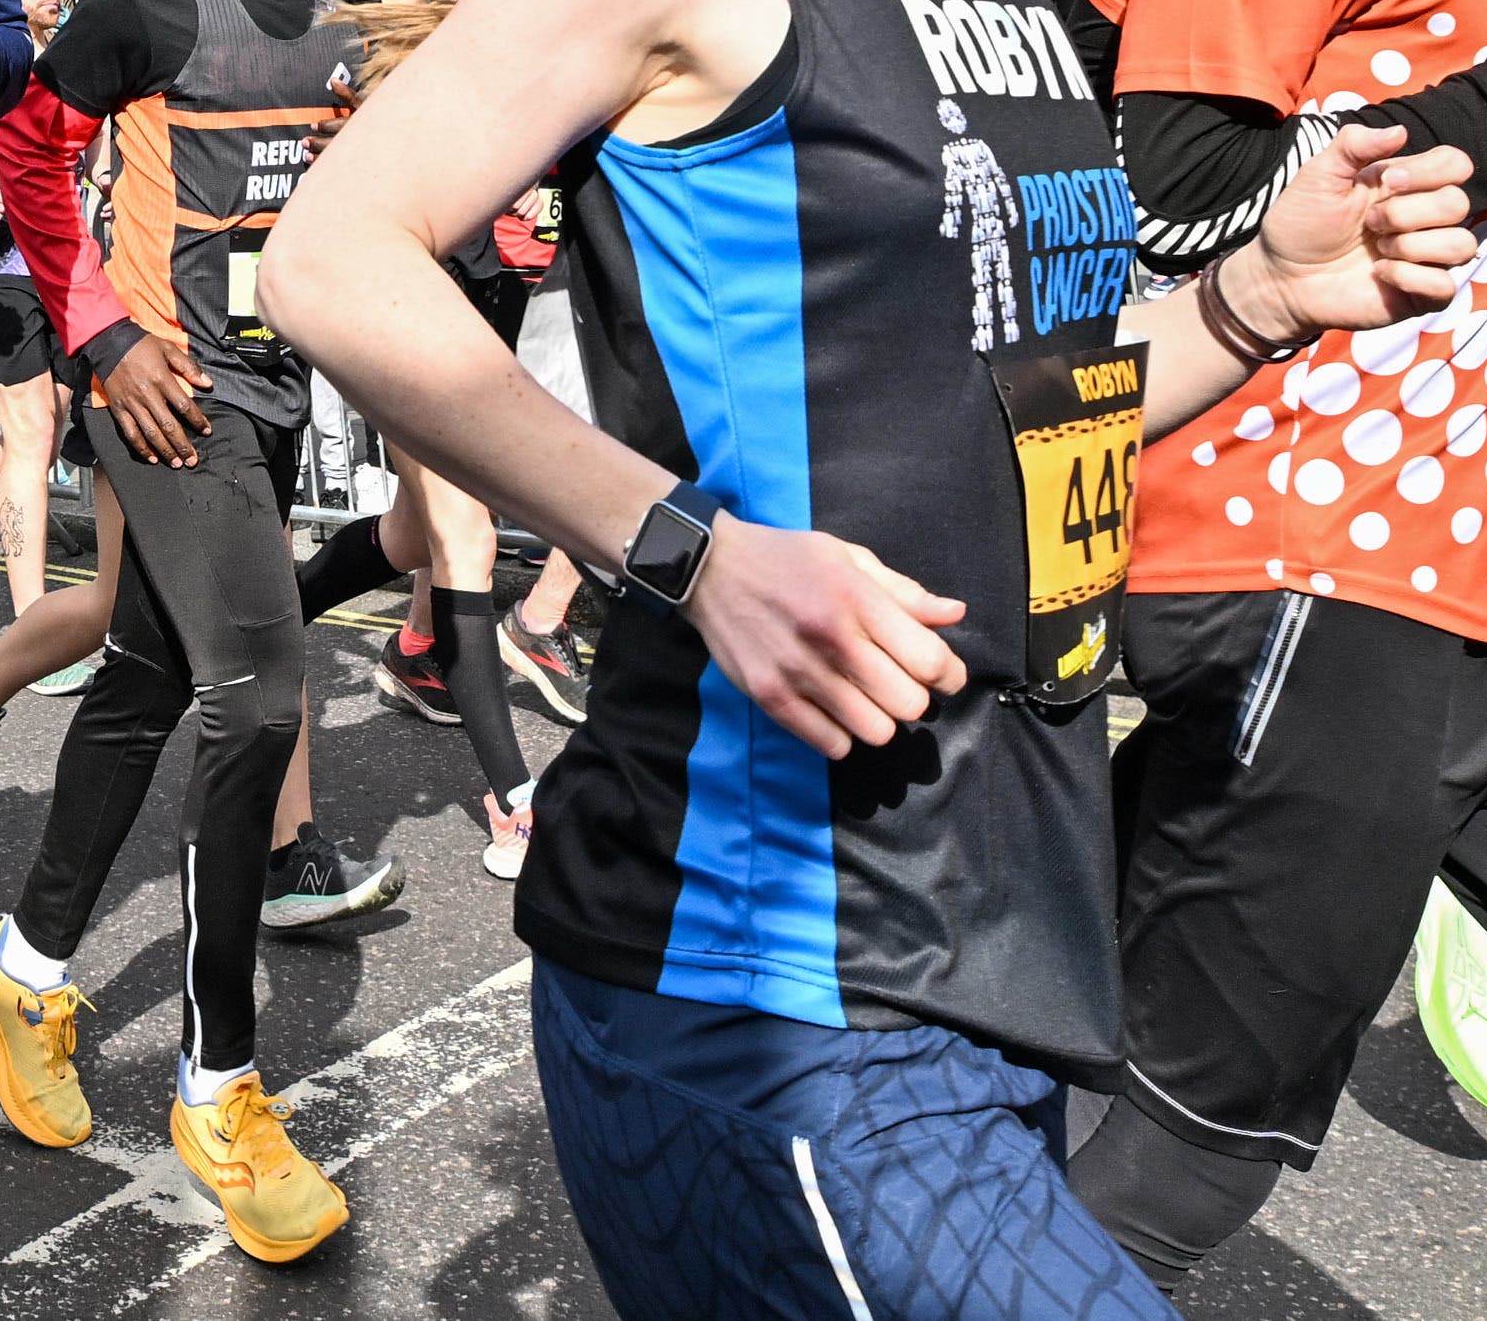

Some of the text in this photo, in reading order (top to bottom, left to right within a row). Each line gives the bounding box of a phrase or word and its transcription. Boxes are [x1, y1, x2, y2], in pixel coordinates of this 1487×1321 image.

[251, 139, 310, 167] REFU
[245, 174, 292, 202] RUN
[1072, 358, 1139, 403] ROBYN
